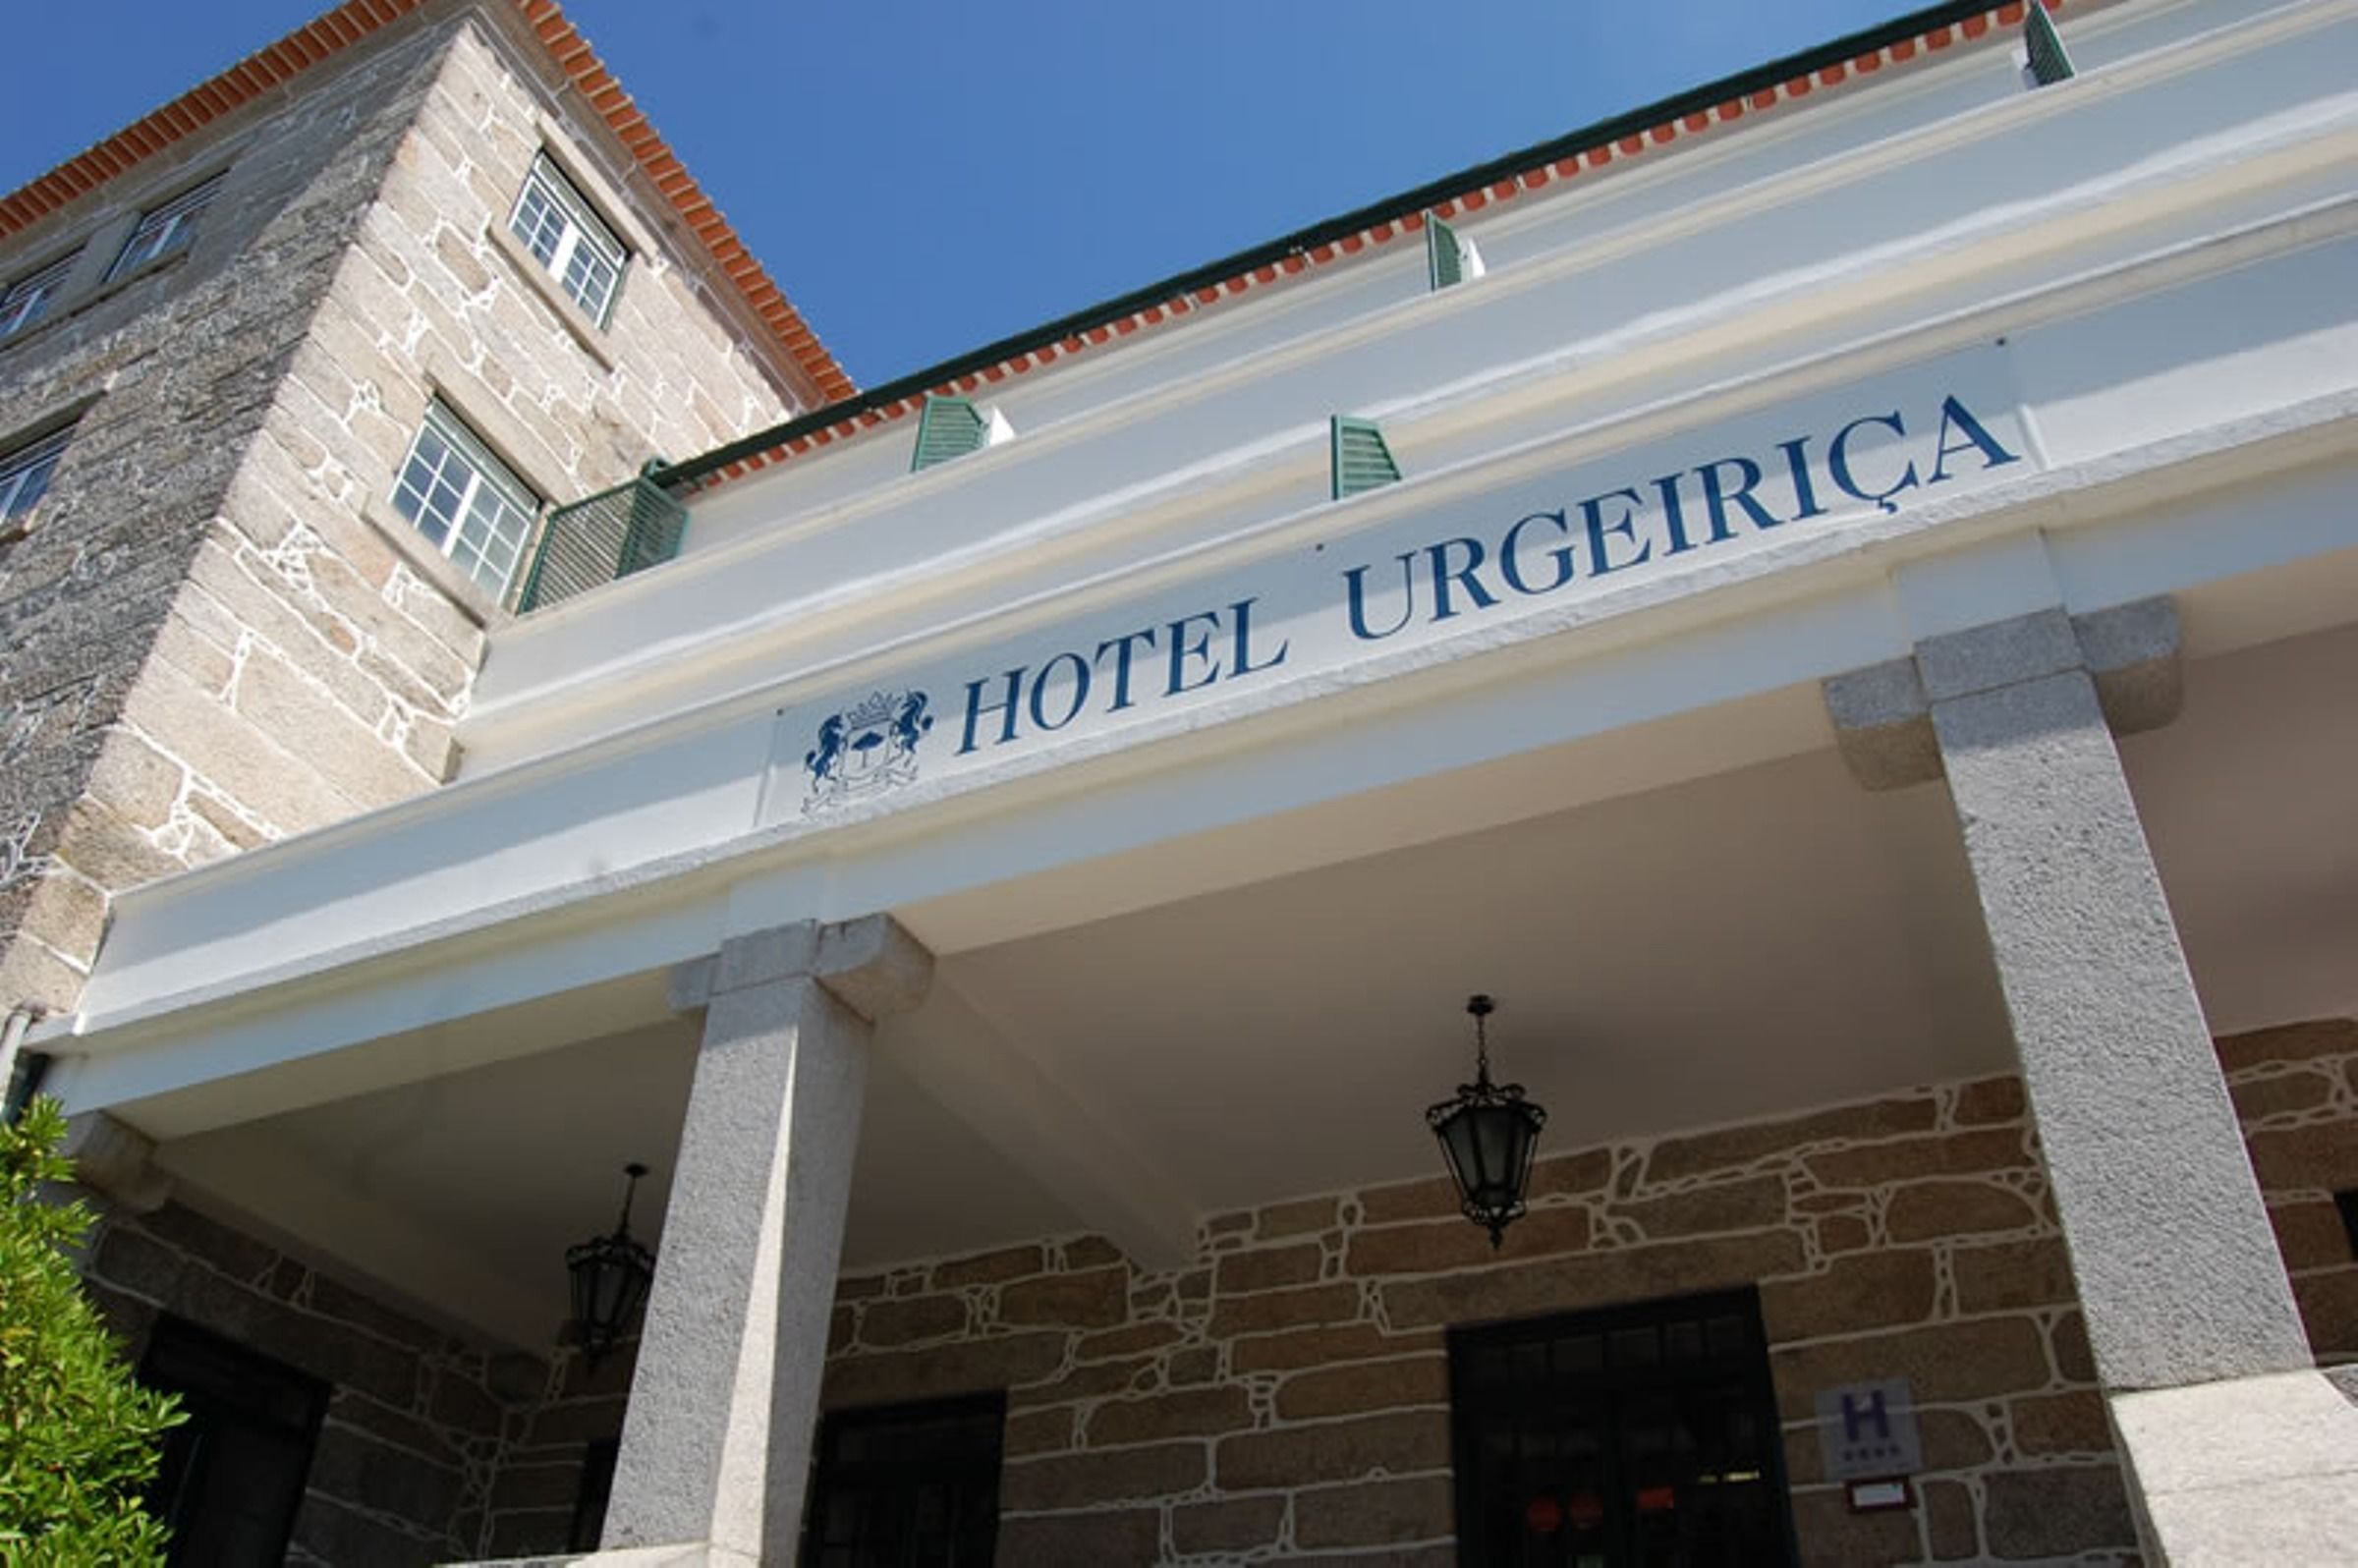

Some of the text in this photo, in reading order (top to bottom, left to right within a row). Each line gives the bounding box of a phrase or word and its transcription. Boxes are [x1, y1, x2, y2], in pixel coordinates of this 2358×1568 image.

[955, 394, 2021, 756] HOTEL URGEIRIÇA
[1842, 1390, 1889, 1441] H
